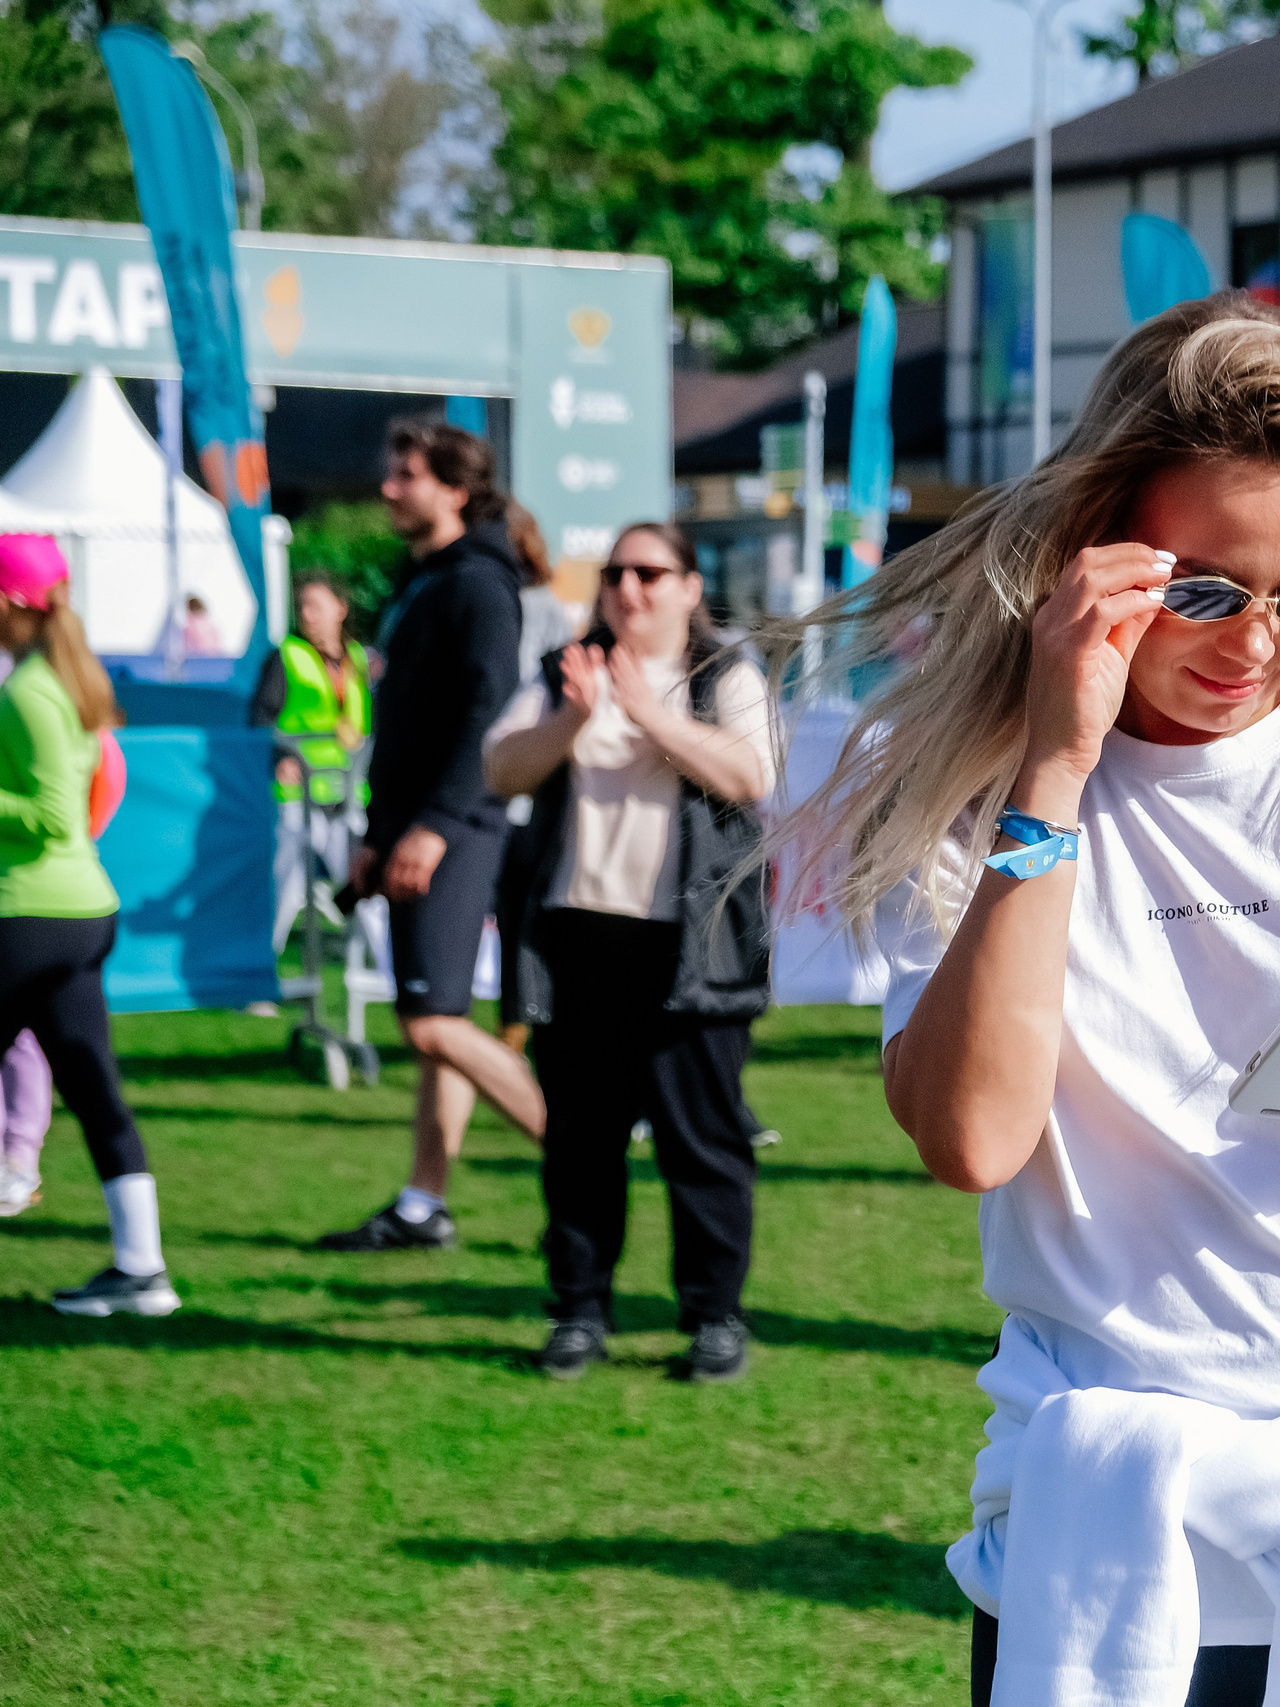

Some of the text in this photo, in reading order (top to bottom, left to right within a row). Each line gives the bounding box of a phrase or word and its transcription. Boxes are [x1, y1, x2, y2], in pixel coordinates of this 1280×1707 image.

[0, 257, 168, 349] ТАР
[1147, 904, 1193, 921] ICONO
[1196, 899, 1270, 916] COUTURE
